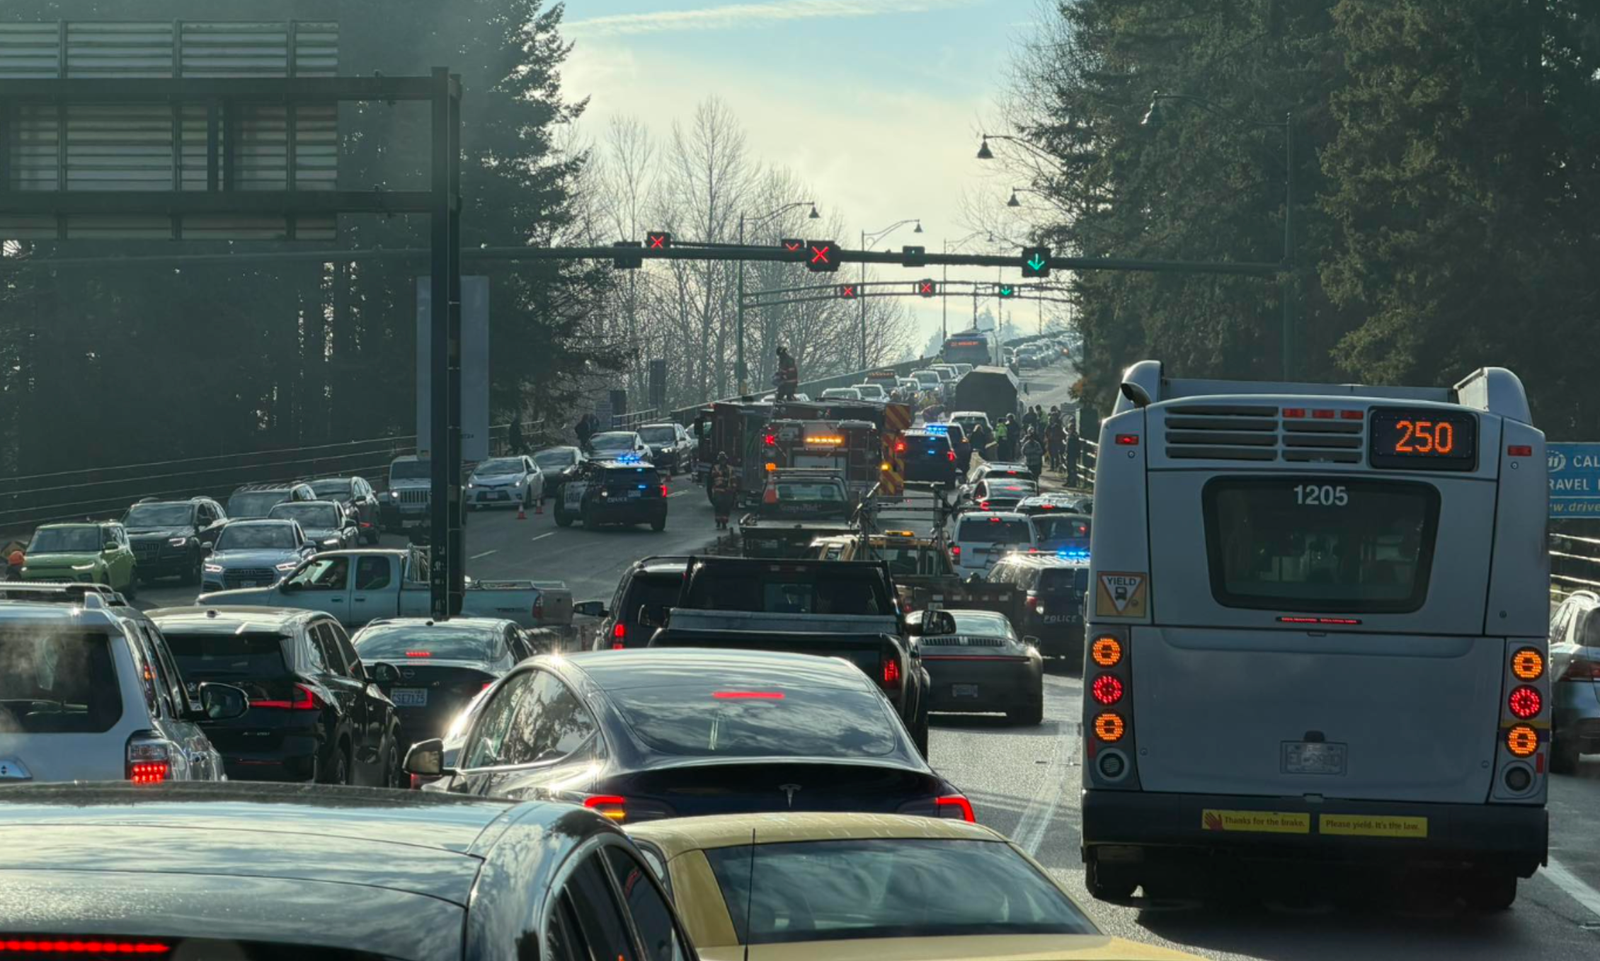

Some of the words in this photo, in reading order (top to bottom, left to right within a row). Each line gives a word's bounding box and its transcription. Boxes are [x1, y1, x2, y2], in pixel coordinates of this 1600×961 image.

[1395, 420, 1453, 453] 250
[1549, 478, 1590, 491] RAVEL
[1293, 484, 1349, 506] 1205
[1549, 501, 1600, 512] w.drive
[1106, 576, 1137, 586] YIELD
[1043, 614, 1077, 623] POLICE
[1225, 816, 1251, 825] Thanks
[1253, 816, 1265, 825] for
[1266, 817, 1279, 826] the
[1281, 818, 1306, 827] brake.
[1325, 819, 1351, 828] Please
[1375, 821, 1387, 829] It's
[1388, 821, 1402, 829] the
[1403, 822, 1420, 830] law.
